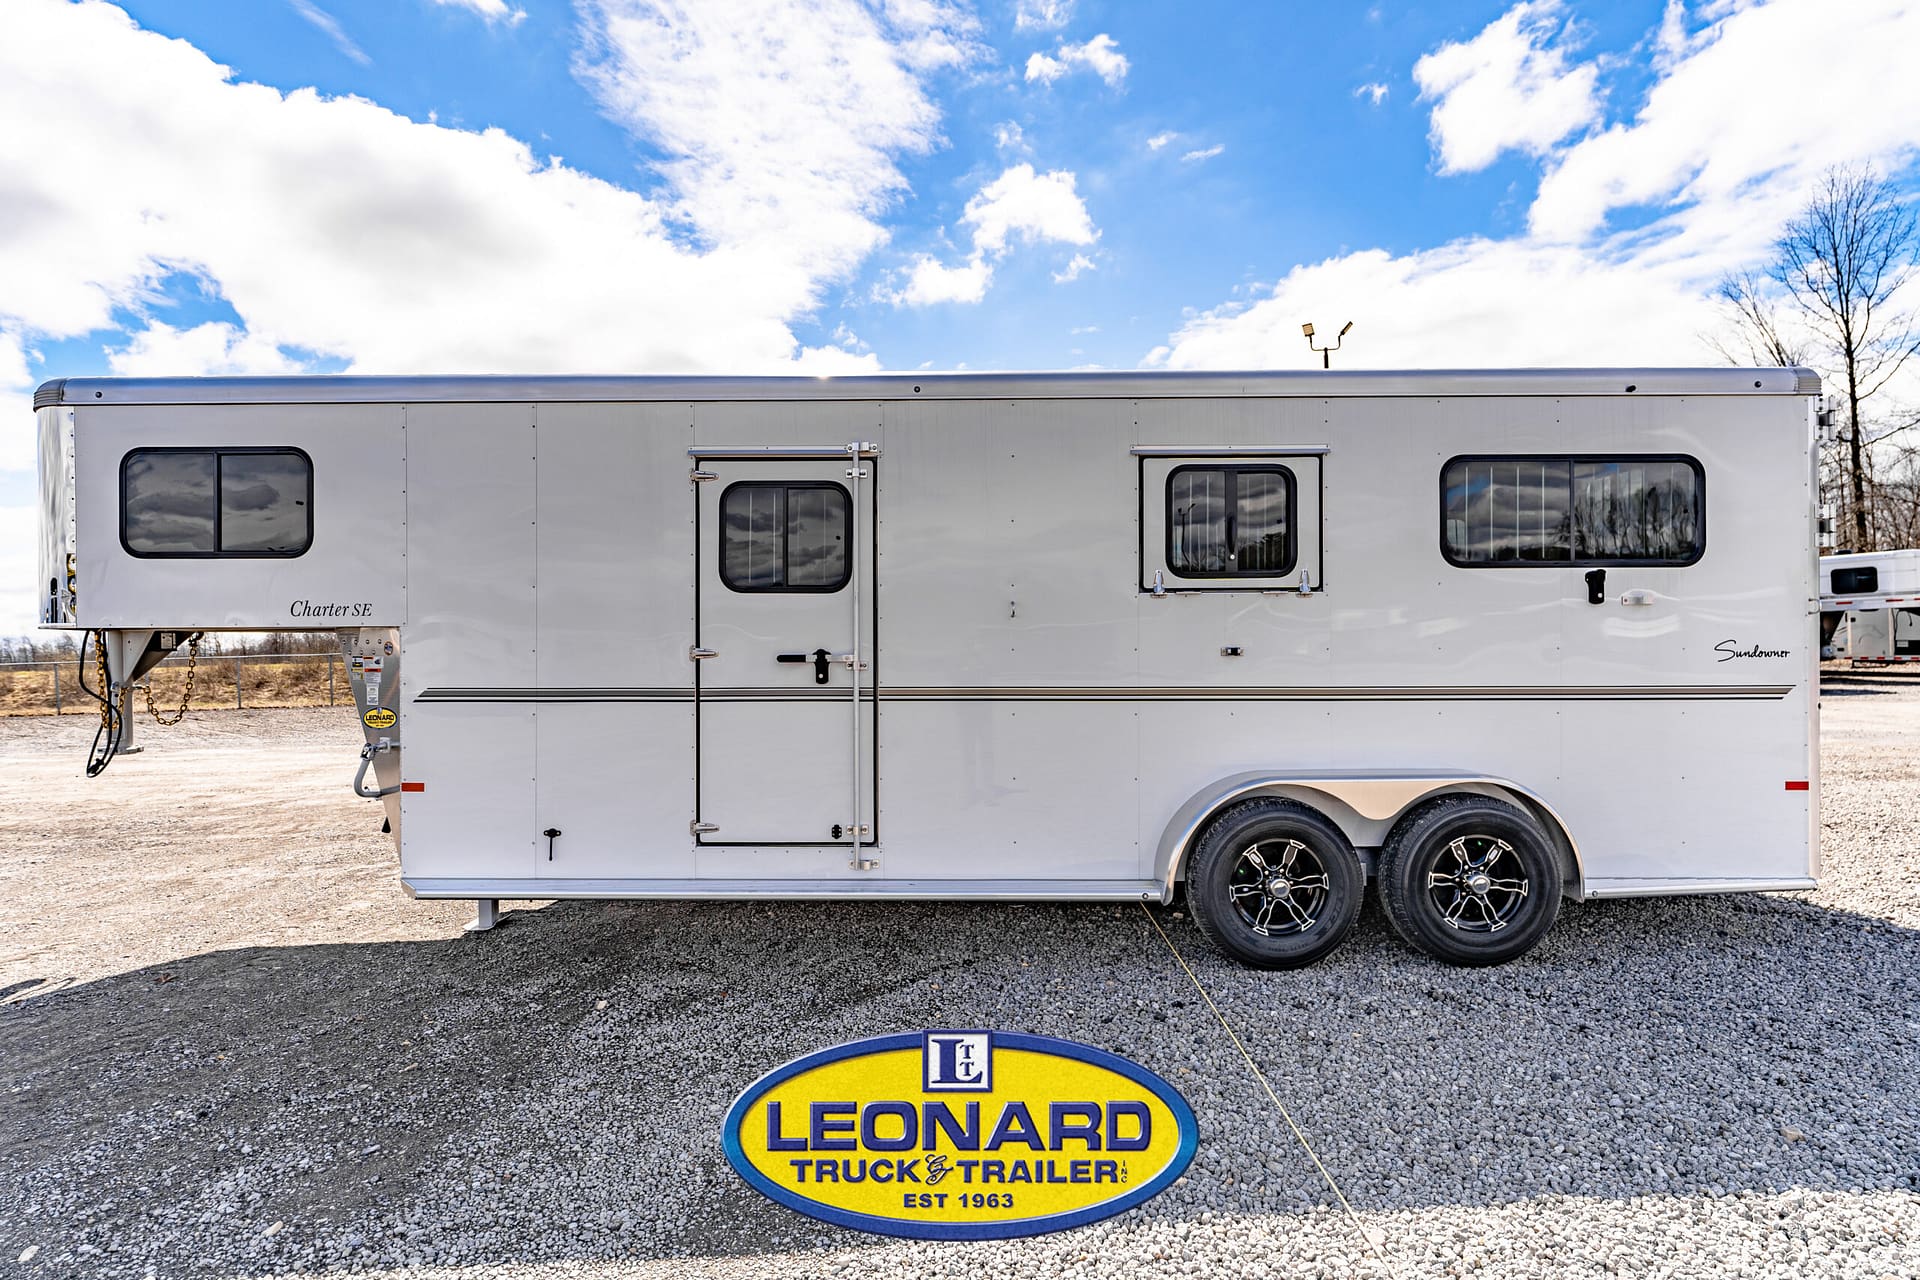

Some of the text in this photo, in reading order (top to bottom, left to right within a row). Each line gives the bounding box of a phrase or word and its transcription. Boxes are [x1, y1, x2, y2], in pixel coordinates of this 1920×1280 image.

[290, 600, 373, 617] Charter SE
[1714, 639, 1790, 662] Sundowner
